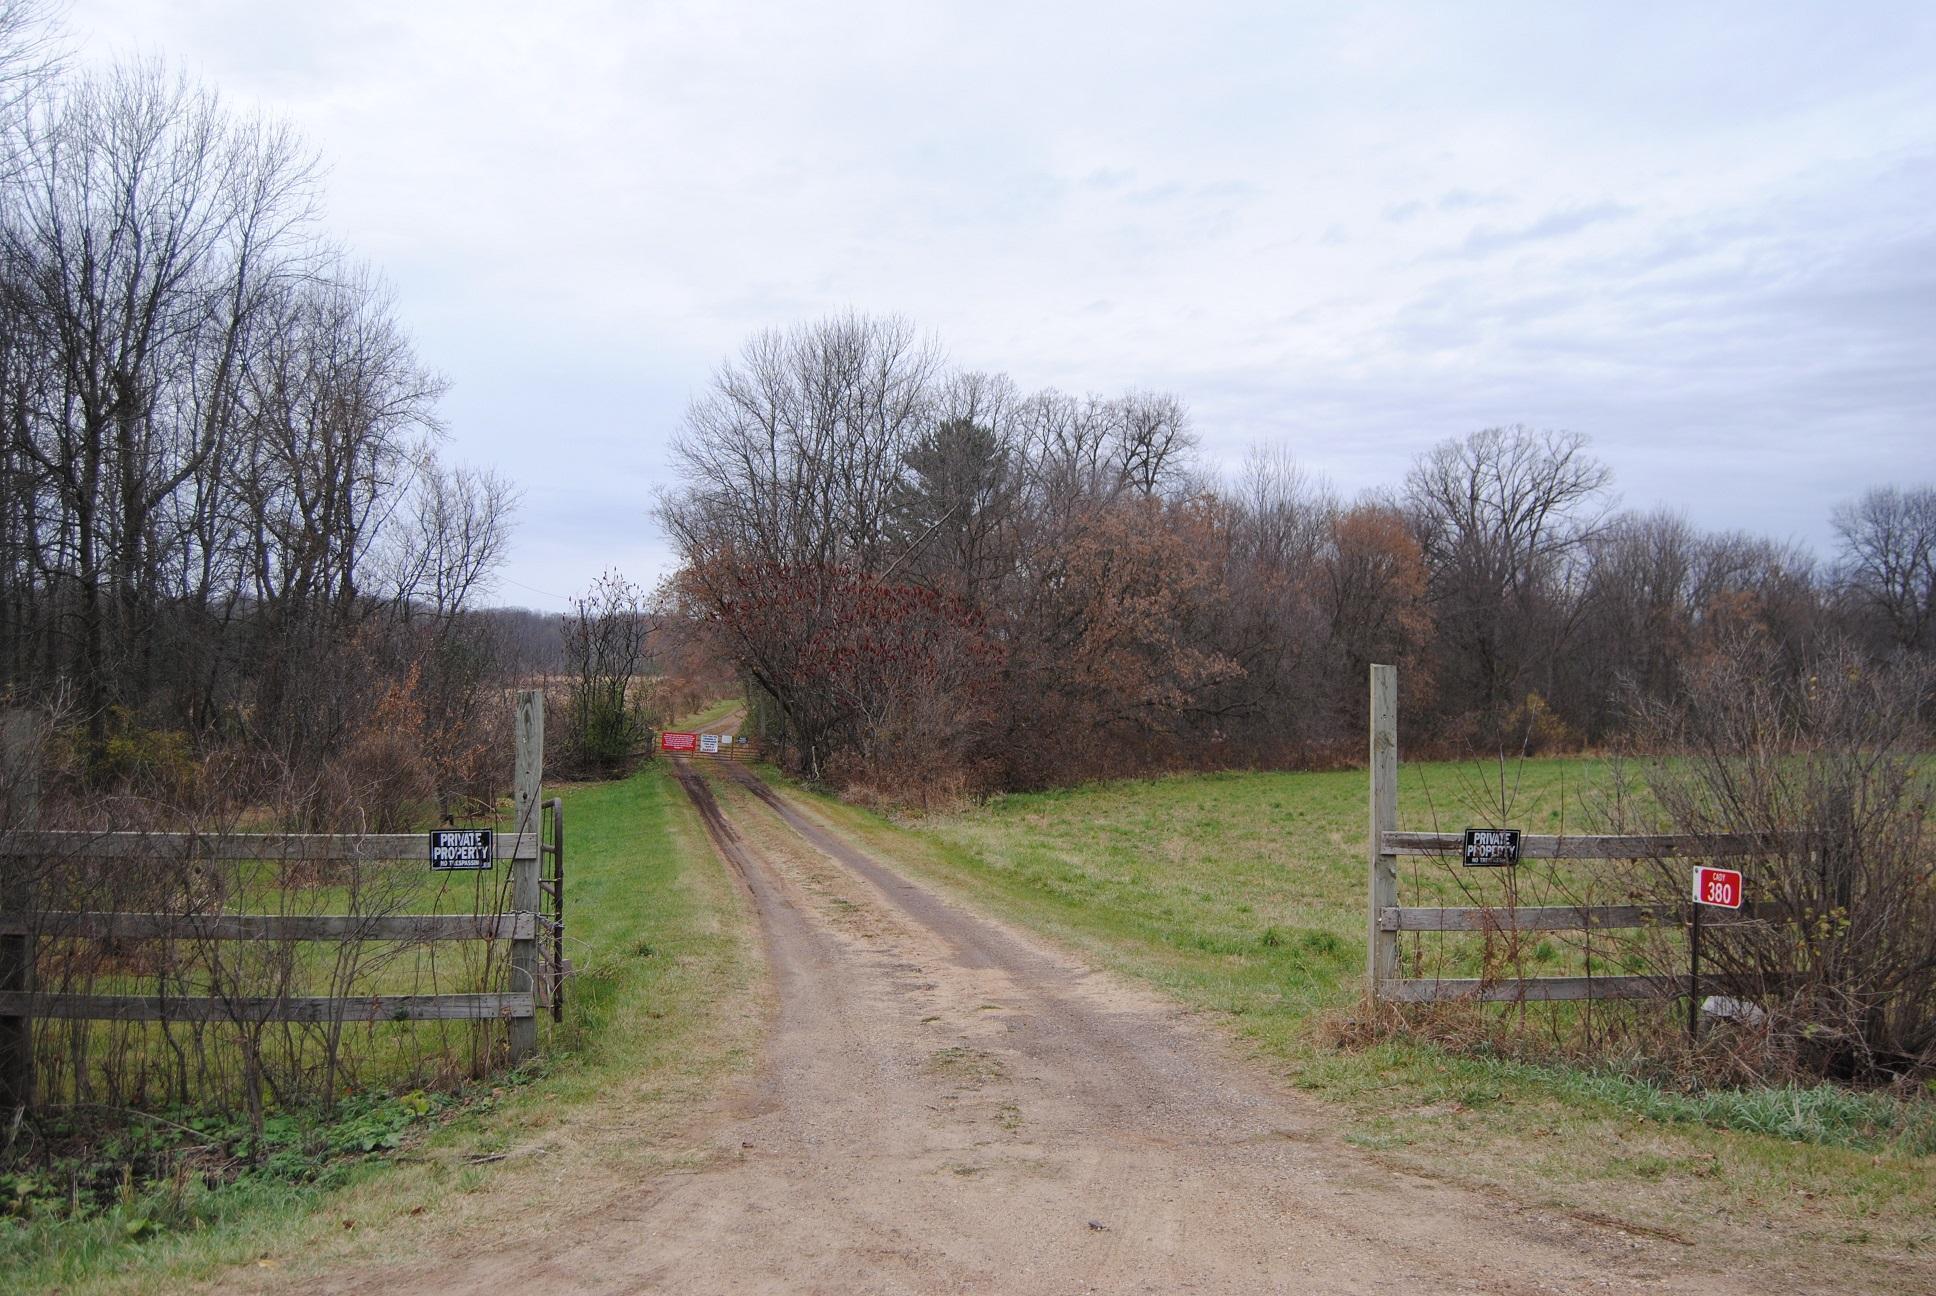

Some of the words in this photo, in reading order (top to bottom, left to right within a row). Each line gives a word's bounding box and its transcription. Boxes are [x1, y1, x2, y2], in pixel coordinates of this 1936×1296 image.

[440, 833, 482, 846] PRIVATE
[1474, 833, 1511, 845] PRIVATE
[433, 846, 488, 860] PROPERTY
[1707, 882, 1732, 904] 380
